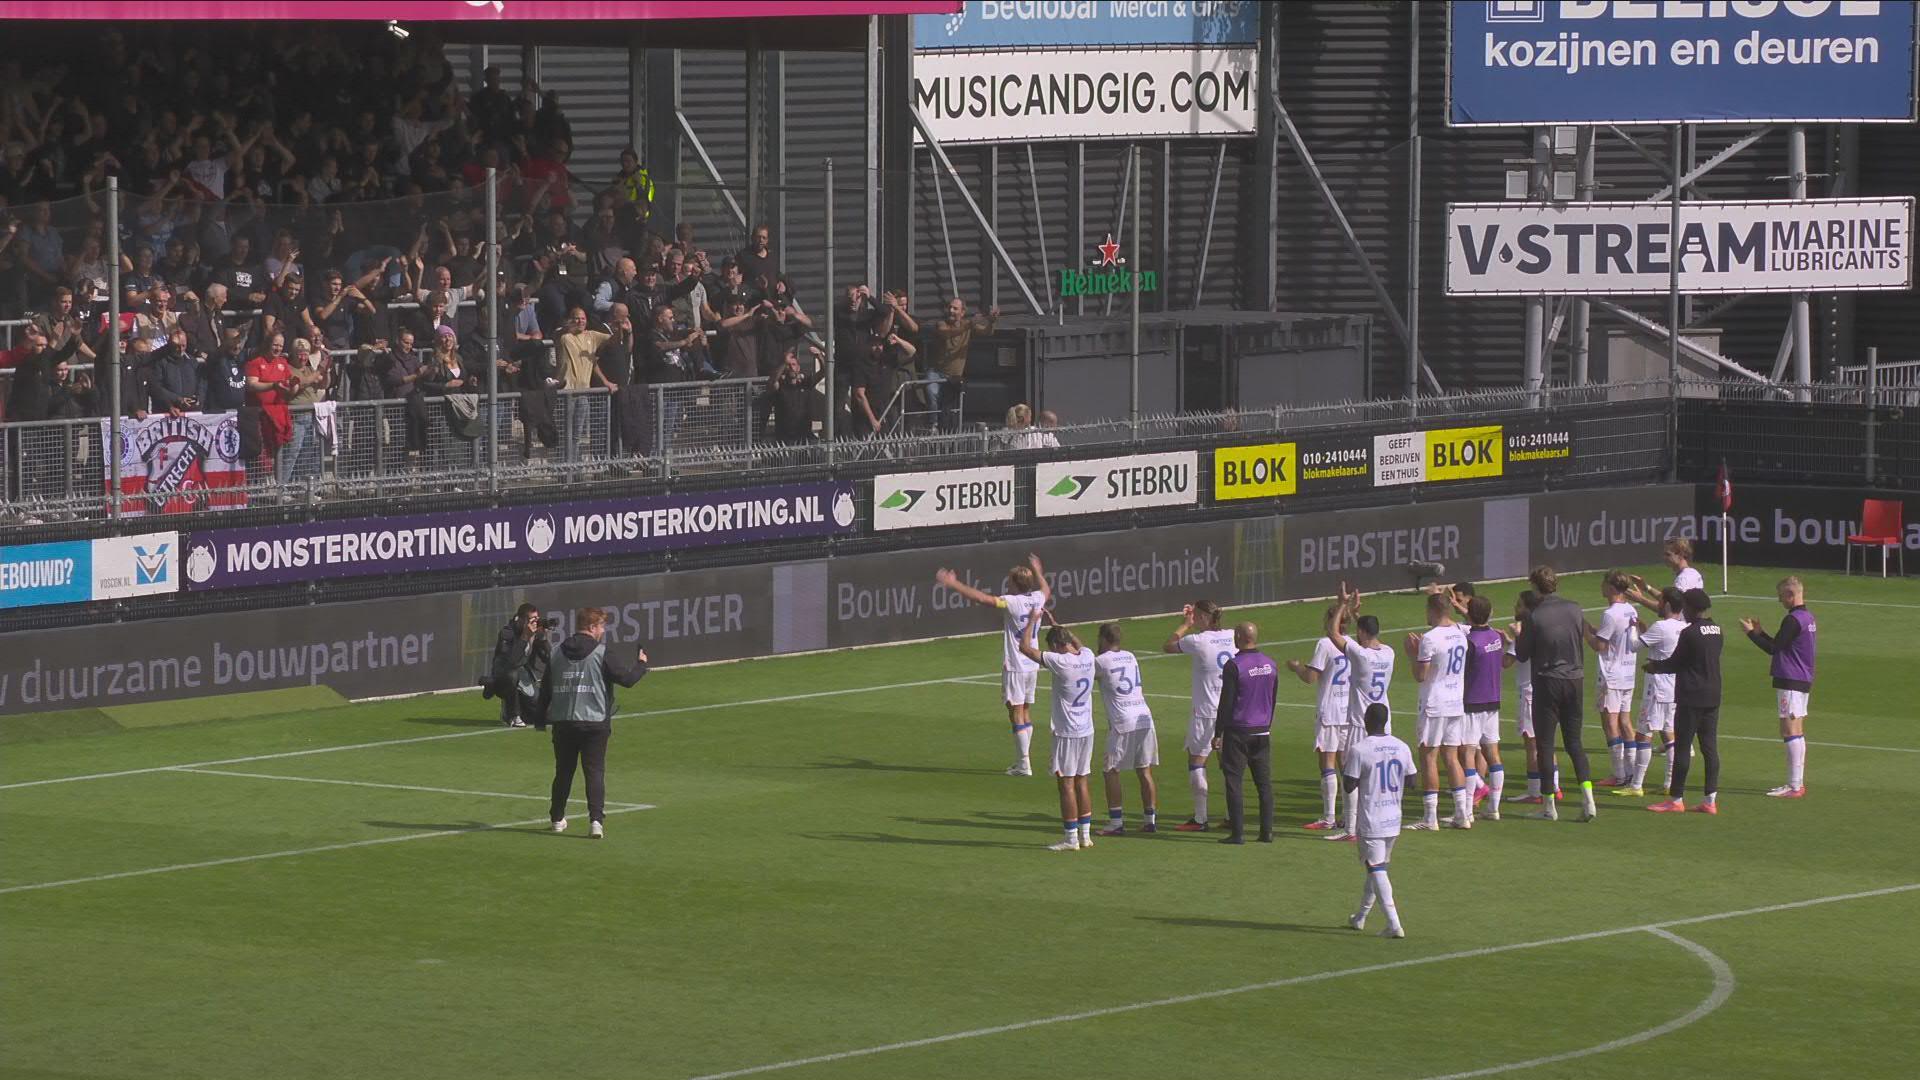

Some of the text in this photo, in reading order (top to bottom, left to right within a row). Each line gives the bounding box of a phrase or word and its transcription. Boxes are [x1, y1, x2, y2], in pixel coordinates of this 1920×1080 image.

[1110, 0, 1167, 18] Merch
[1173, 0, 1187, 17] &
[1485, 31, 1878, 74] kozijnen en deuren
[914, 71, 1249, 119] MUSICANDGIG.COM
[1771, 218, 1901, 251] MARINE
[1771, 249, 1901, 271] LUBRICANTS
[1060, 267, 1157, 296] Heineken
[136, 417, 214, 457] BRITISH
[1388, 438, 1412, 449] GEEFT
[1379, 452, 1420, 466] BEDRIJVEN
[1433, 439, 1494, 468] BLOK
[1509, 446, 1569, 461] blokmakelaars.nl
[1107, 463, 1188, 499] STEBRU
[1224, 456, 1287, 486] BLOK
[1303, 464, 1368, 480] blokmakelaars.nl
[1381, 468, 1419, 480] EEN THUIS
[936, 480, 1011, 511] STEBRU
[564, 495, 825, 544] MONSTERKORTING.NL
[1543, 515, 1580, 550] Uw
[1589, 511, 1760, 547] duurzame
[227, 521, 516, 573] MONSTERKORTING.NL
[1300, 525, 1460, 573] BIERSTEKER
[838, 582, 922, 620] Bouw,
[546, 593, 743, 651] BIRSTEKER
[21, 656, 209, 704] duurzame
[213, 631, 434, 686] bouwpartner
[1446, 645, 1465, 676] 18
[1072, 677, 1090, 707] 2
[1369, 671, 1386, 702] 5
[1375, 758, 1403, 794] 10
